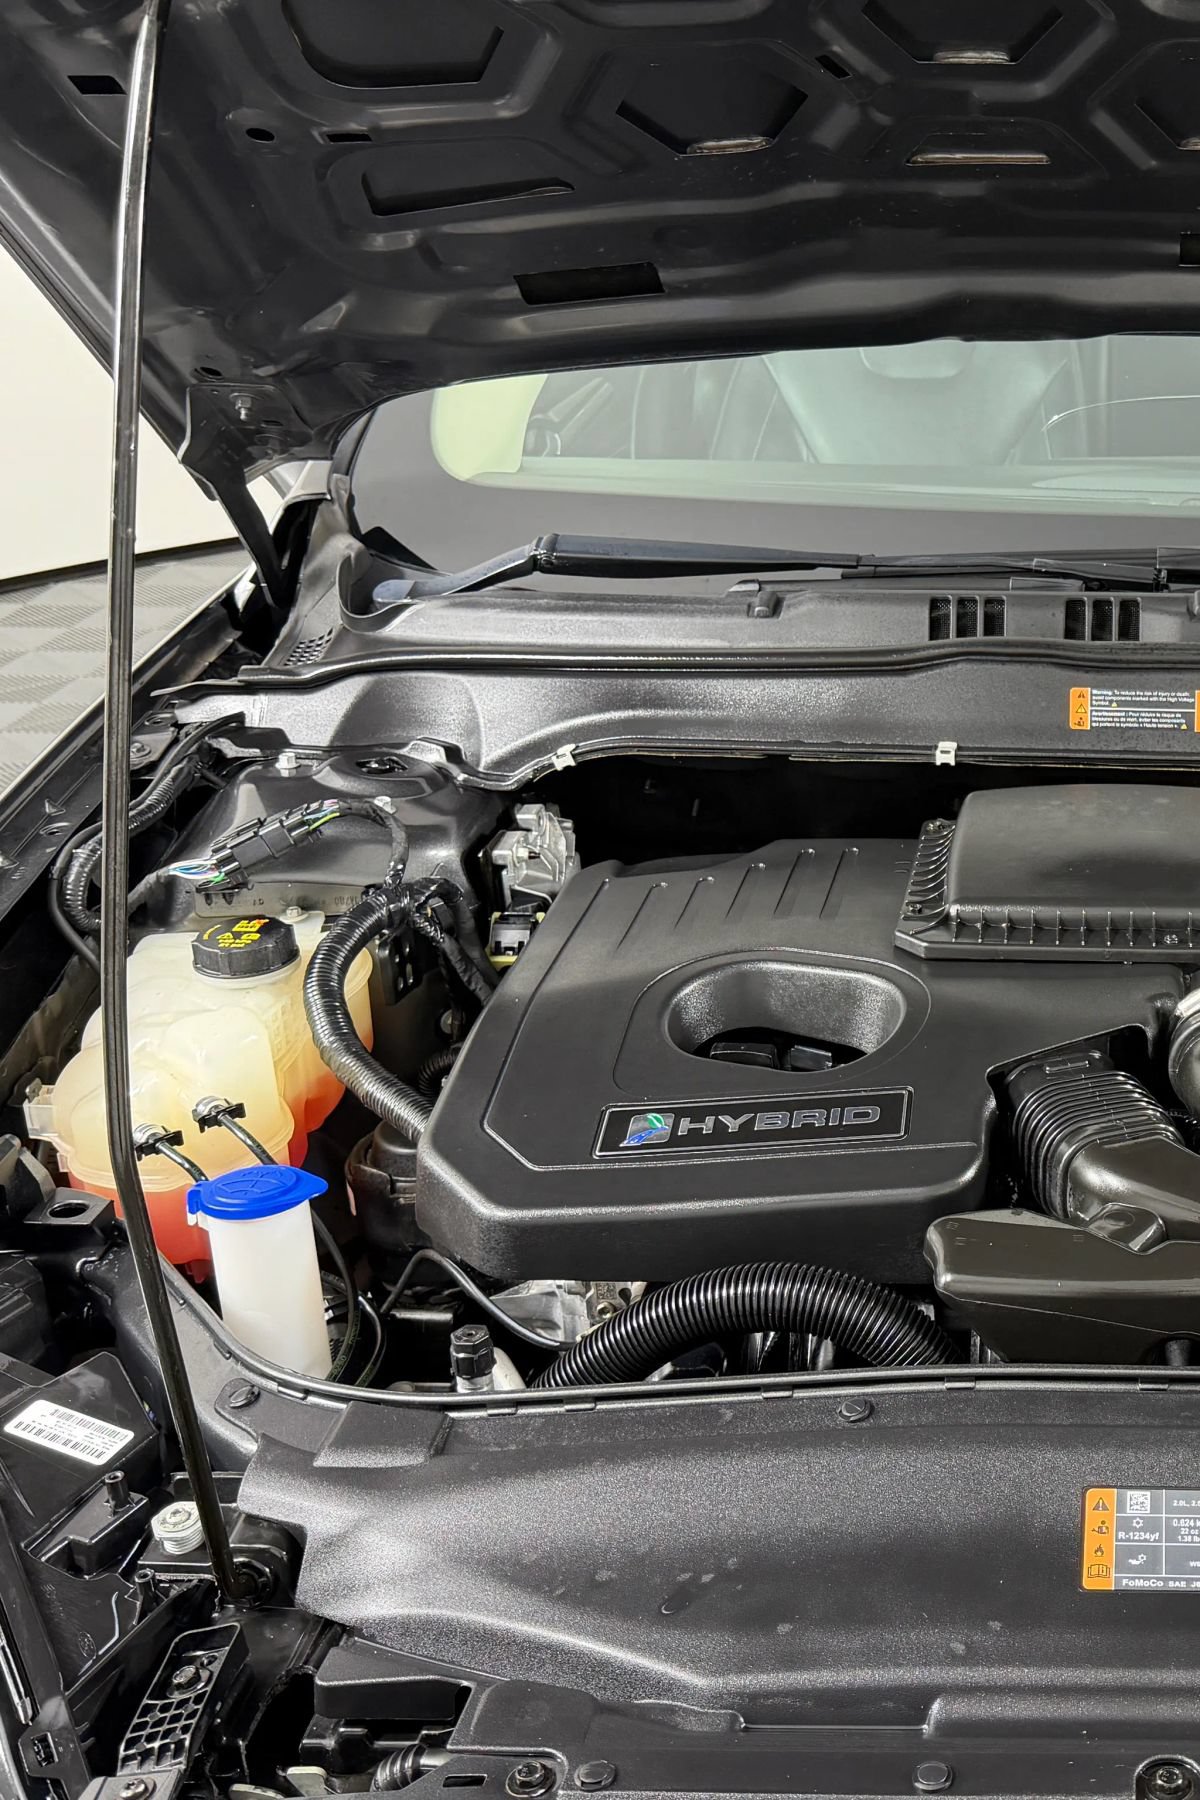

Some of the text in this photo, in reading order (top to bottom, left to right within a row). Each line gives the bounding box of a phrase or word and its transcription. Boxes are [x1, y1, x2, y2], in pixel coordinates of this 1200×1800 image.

[677, 1105, 881, 1136] HYBRID
[1118, 1531, 1160, 1542] R-1234yf
[1122, 1578, 1164, 1588] FoMoCo
[1168, 1580, 1187, 1588] SAE
